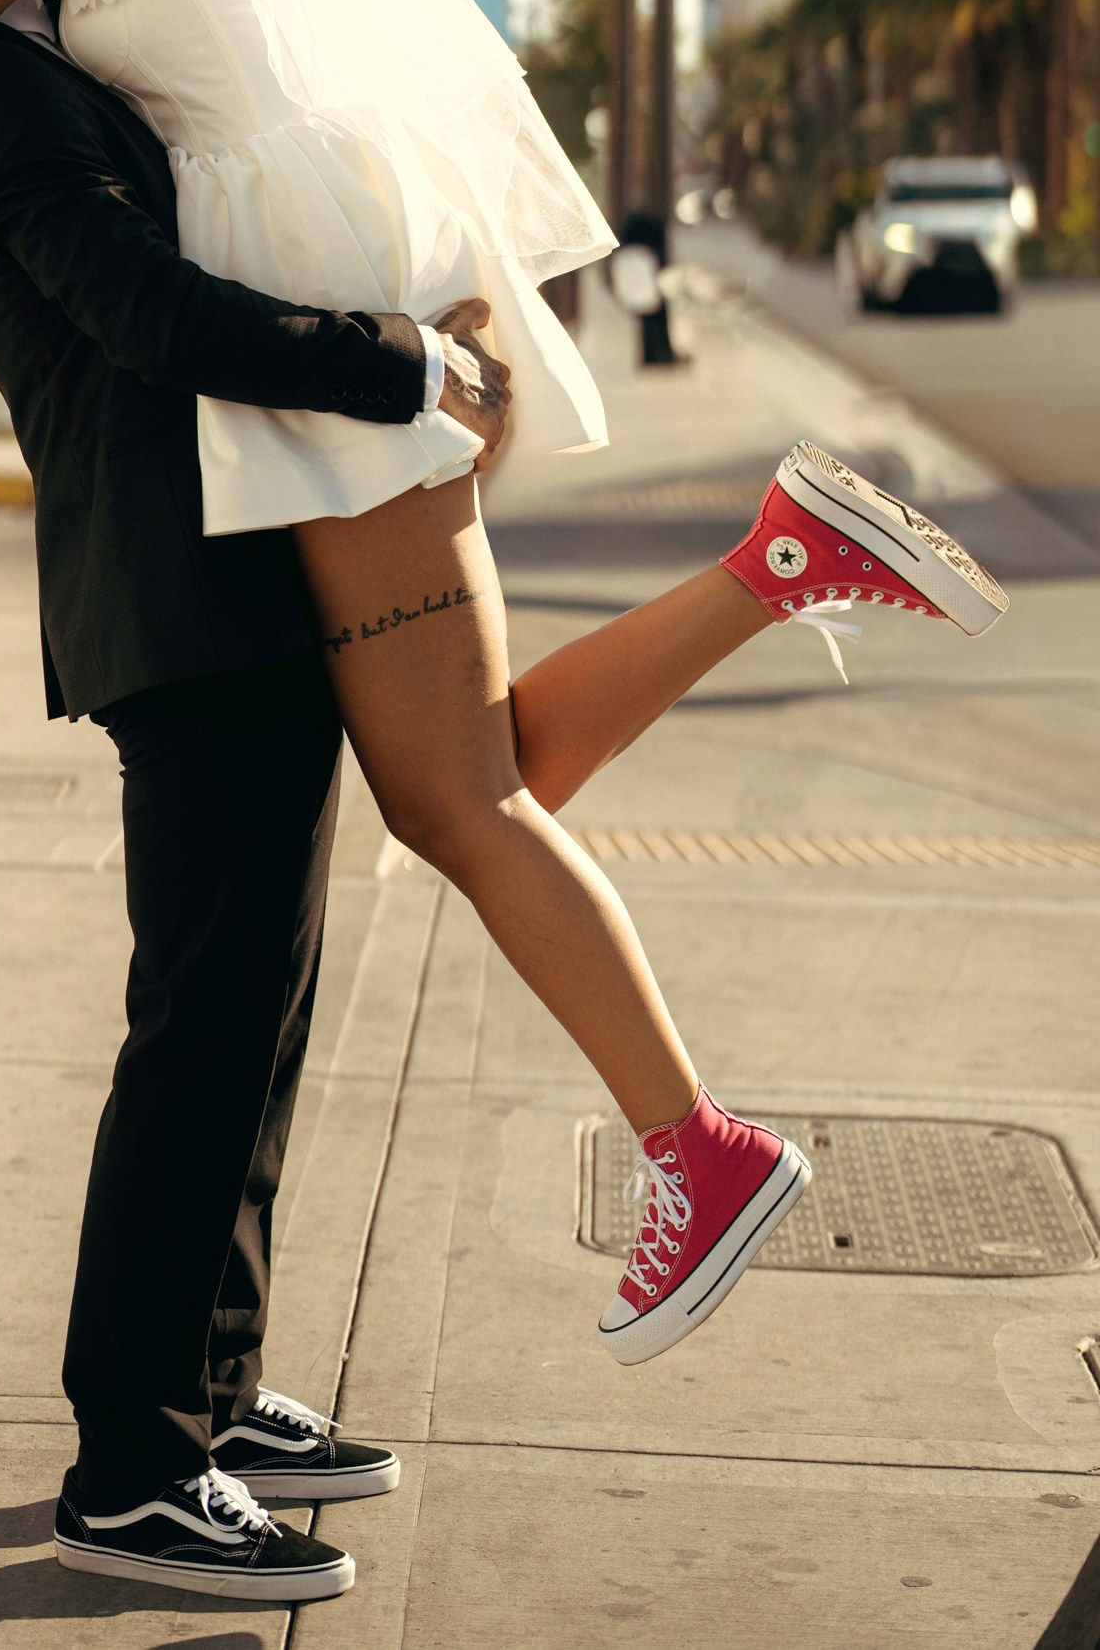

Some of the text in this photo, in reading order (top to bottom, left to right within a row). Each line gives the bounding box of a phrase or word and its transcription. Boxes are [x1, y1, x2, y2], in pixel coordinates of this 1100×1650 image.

[782, 539, 799, 549] STAR
[769, 550, 795, 575] CONVERSE
[797, 549, 805, 561] ALL
[361, 615, 388, 640] but
[390, 607, 404, 628] I
[423, 591, 452, 614] hard
